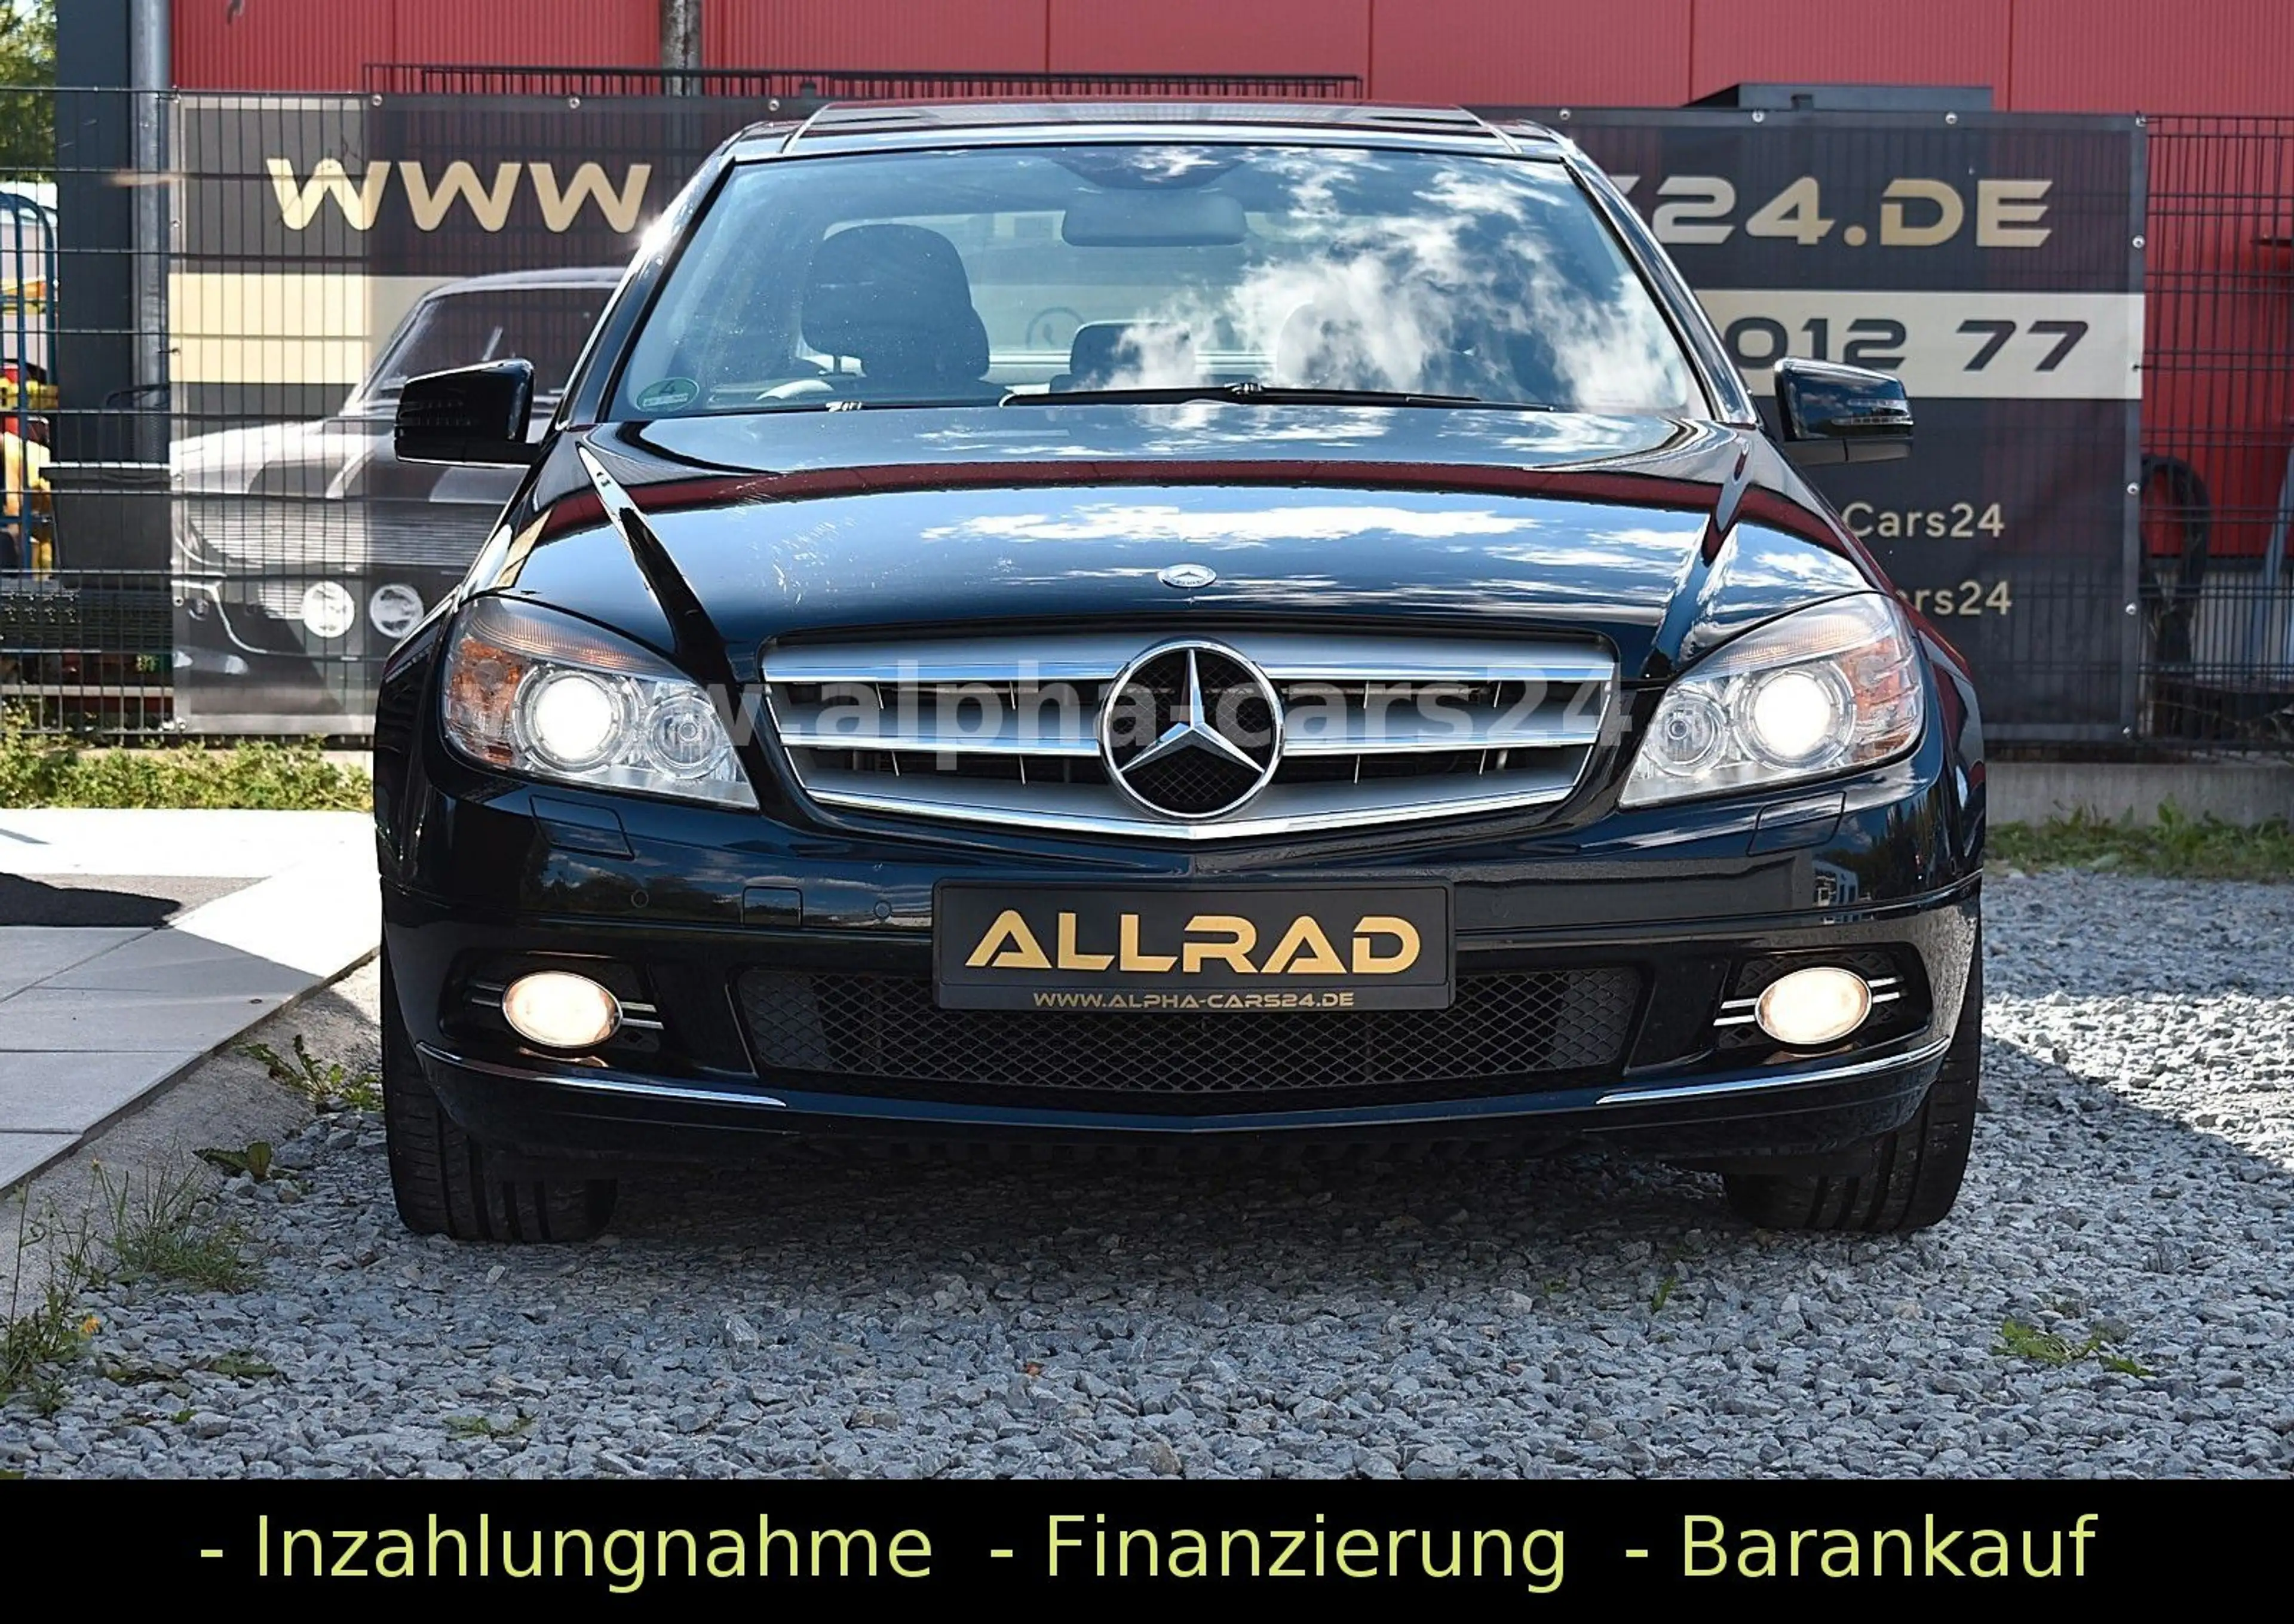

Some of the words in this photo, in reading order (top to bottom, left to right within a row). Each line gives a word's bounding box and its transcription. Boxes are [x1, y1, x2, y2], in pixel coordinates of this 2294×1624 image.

[1609, 175, 2054, 248] 24.DE
[1955, 320, 2089, 373] 77
[1841, 501, 2005, 538] Cars24
[965, 909, 1422, 975] ALLRAD
[1032, 991, 1355, 1011] WWW.ALPHA-CARS24.DE
